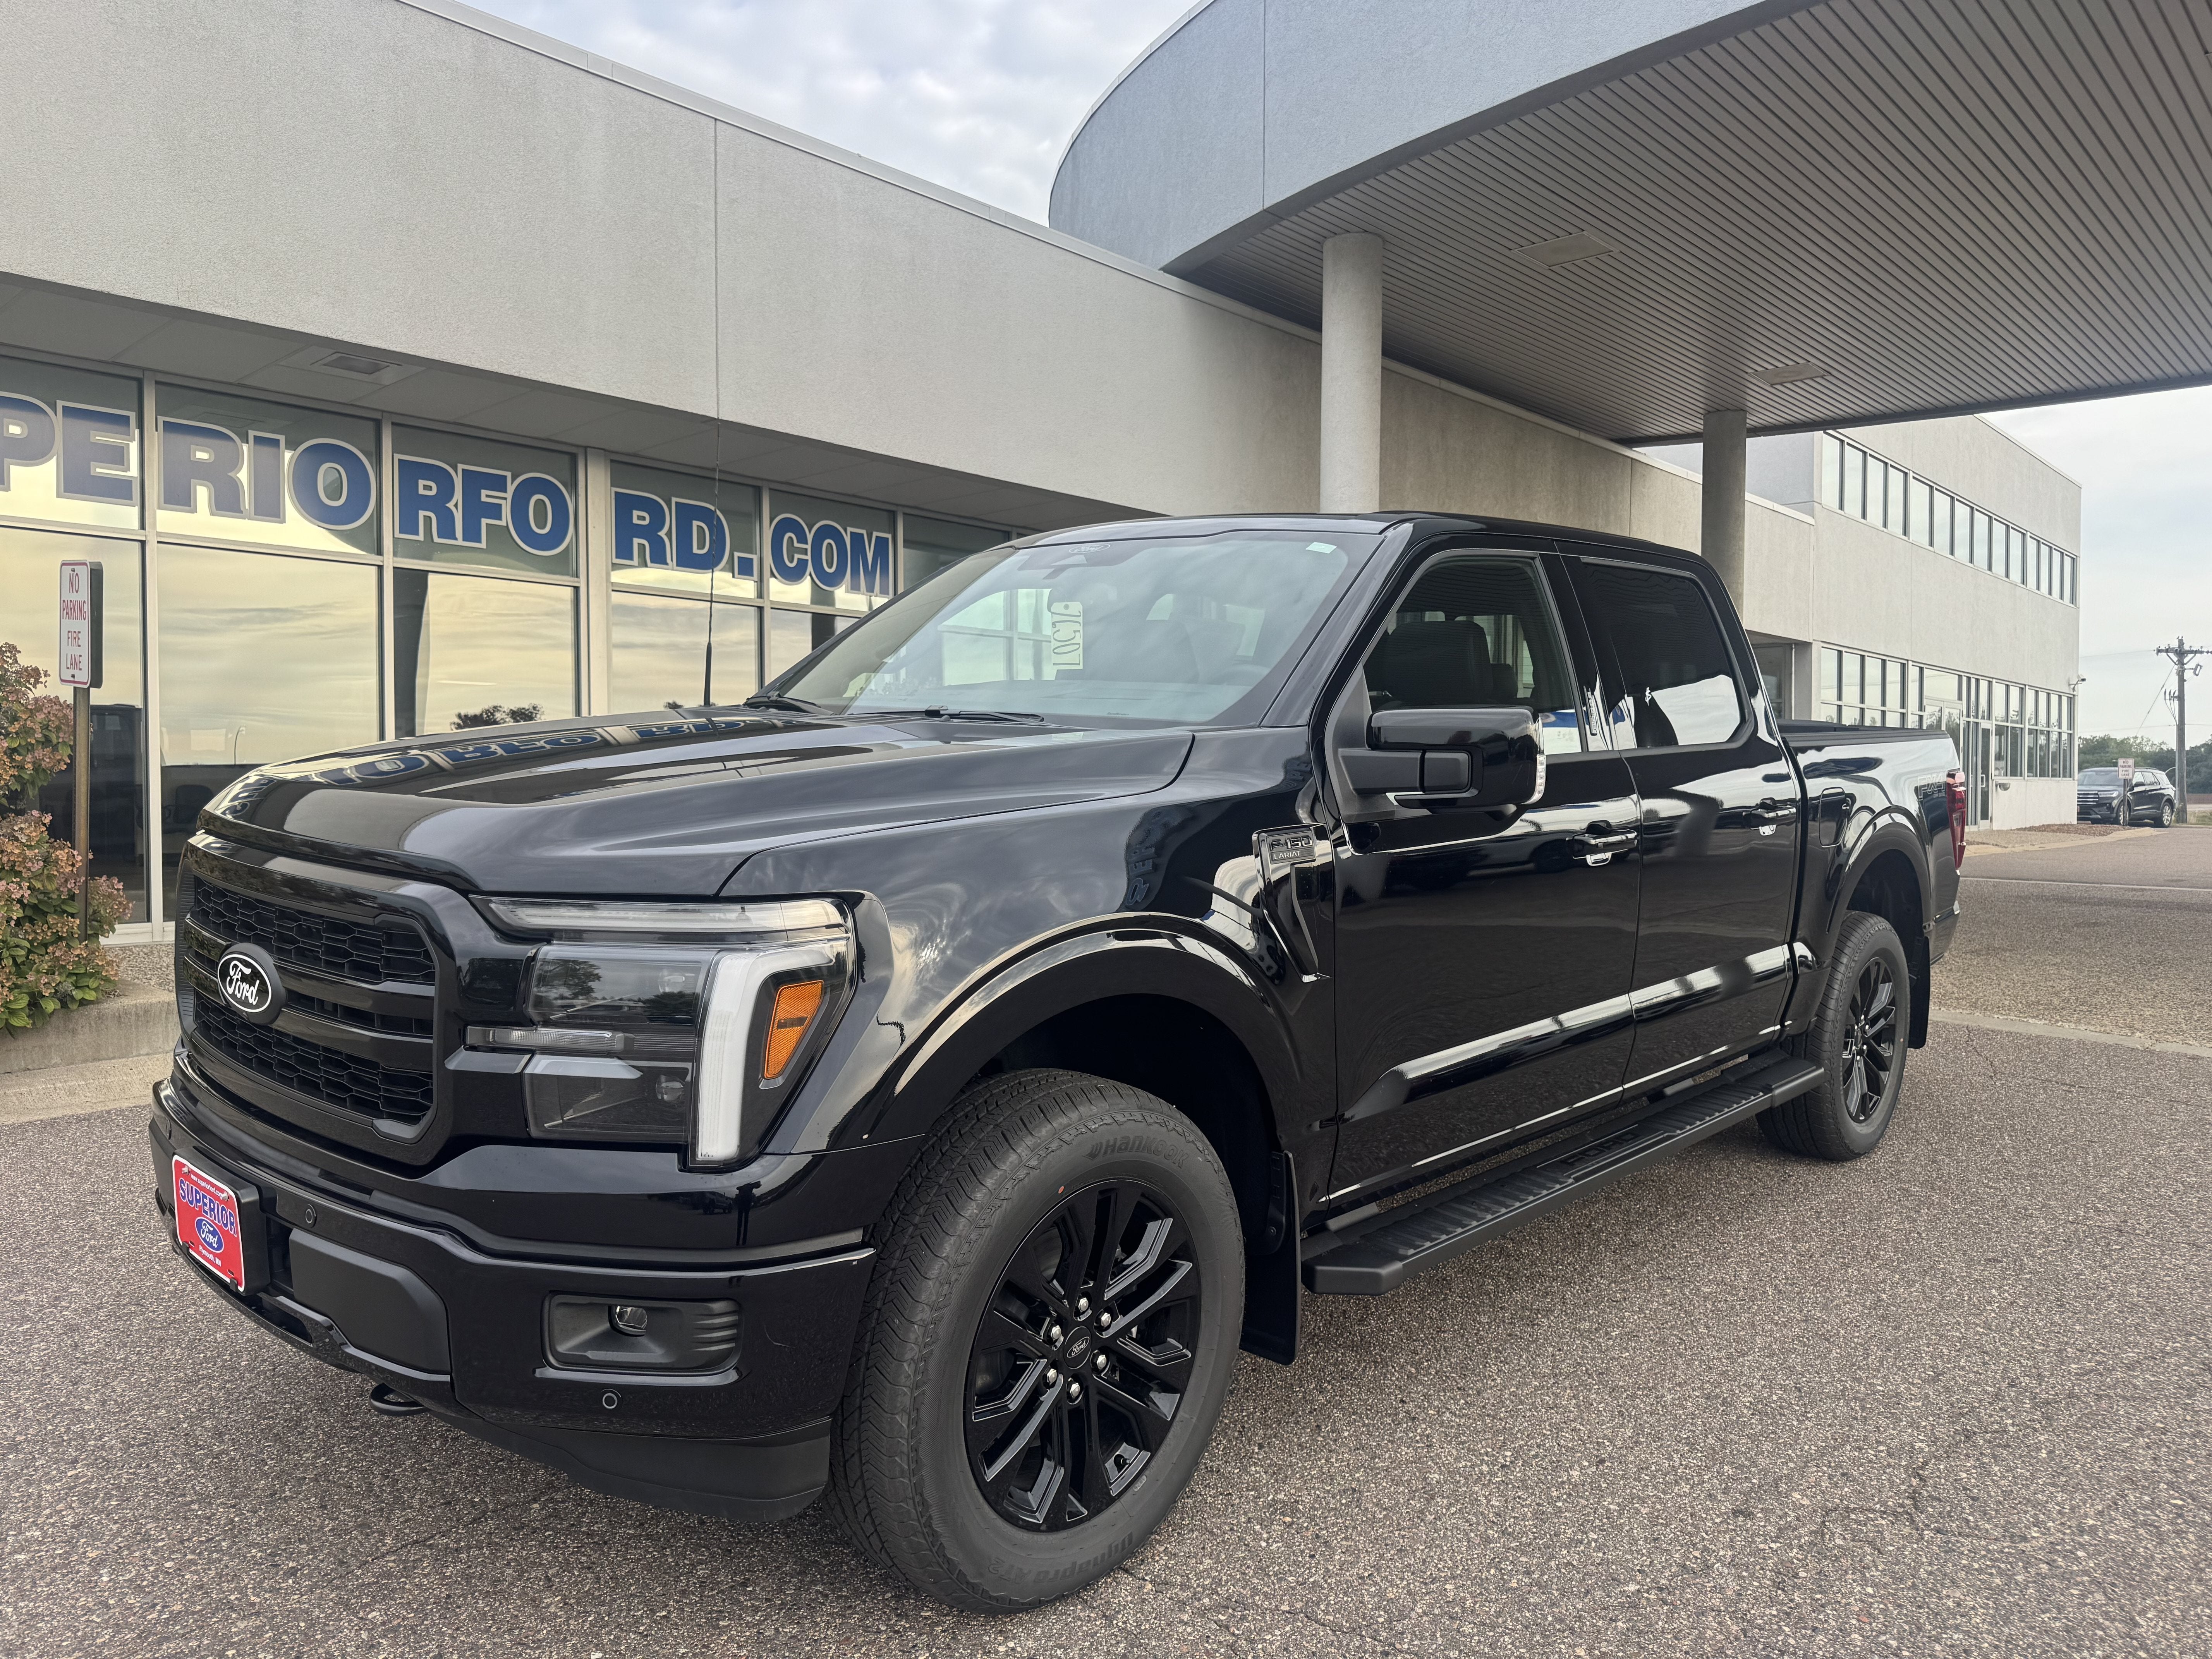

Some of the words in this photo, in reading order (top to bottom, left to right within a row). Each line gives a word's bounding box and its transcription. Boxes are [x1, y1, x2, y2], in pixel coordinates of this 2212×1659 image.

[69, 573, 79, 593] NO
[62, 600, 86, 620] PARKING
[67, 631, 81, 647] FIRE
[66, 653, 82, 671] LANE
[1918, 772, 1945, 801] FX4
[1270, 835, 1312, 851] F-150
[1274, 850, 1300, 860] LARIAT
[226, 960, 260, 1005] Ford
[1560, 1132, 1642, 1166] FORD
[179, 1178, 237, 1238] SUPERIOR
[200, 1220, 219, 1249] Ford
[1071, 1339, 1087, 1356] Ford
